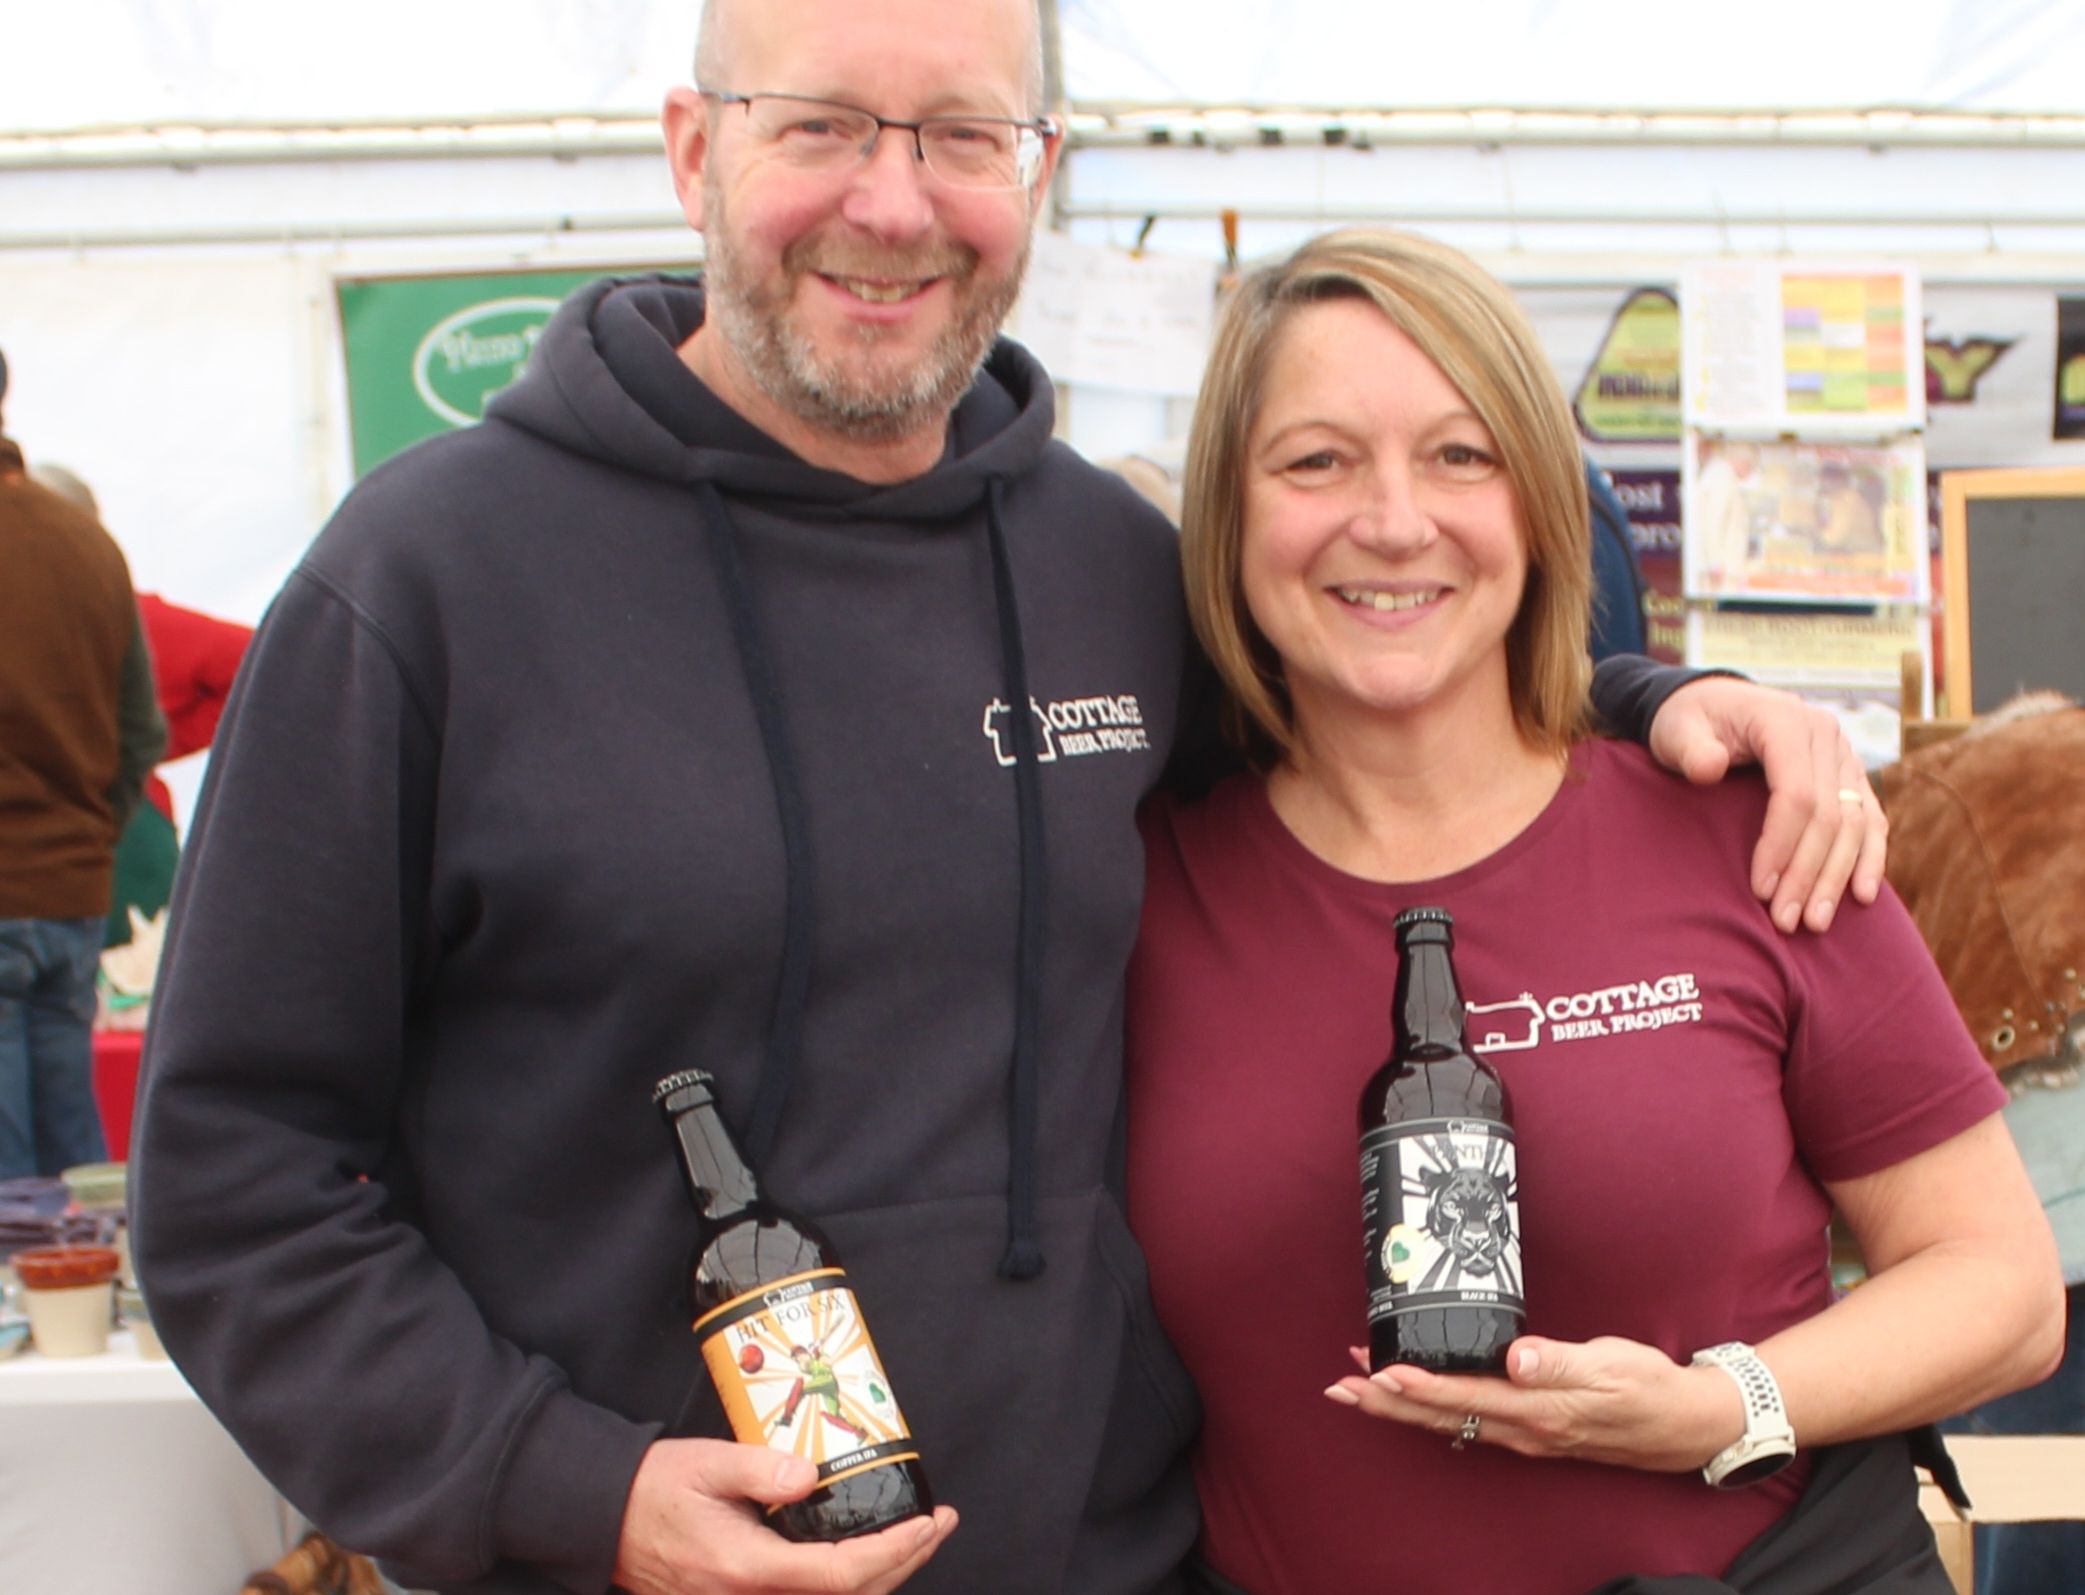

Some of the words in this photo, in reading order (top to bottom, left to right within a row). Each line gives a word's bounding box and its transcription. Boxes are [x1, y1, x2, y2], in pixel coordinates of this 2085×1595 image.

[1049, 695, 1142, 730] COTTAGE
[1059, 733, 1100, 756] BEER
[1098, 728, 1151, 752] PROJECT
[1546, 973, 1699, 1019] COTTAGE
[1551, 1018, 1608, 1041] BEER
[1611, 1003, 1703, 1031] PROJECT
[736, 1314, 769, 1345] HIT
[774, 1301, 818, 1327] FOR
[816, 1291, 847, 1314] SIX
